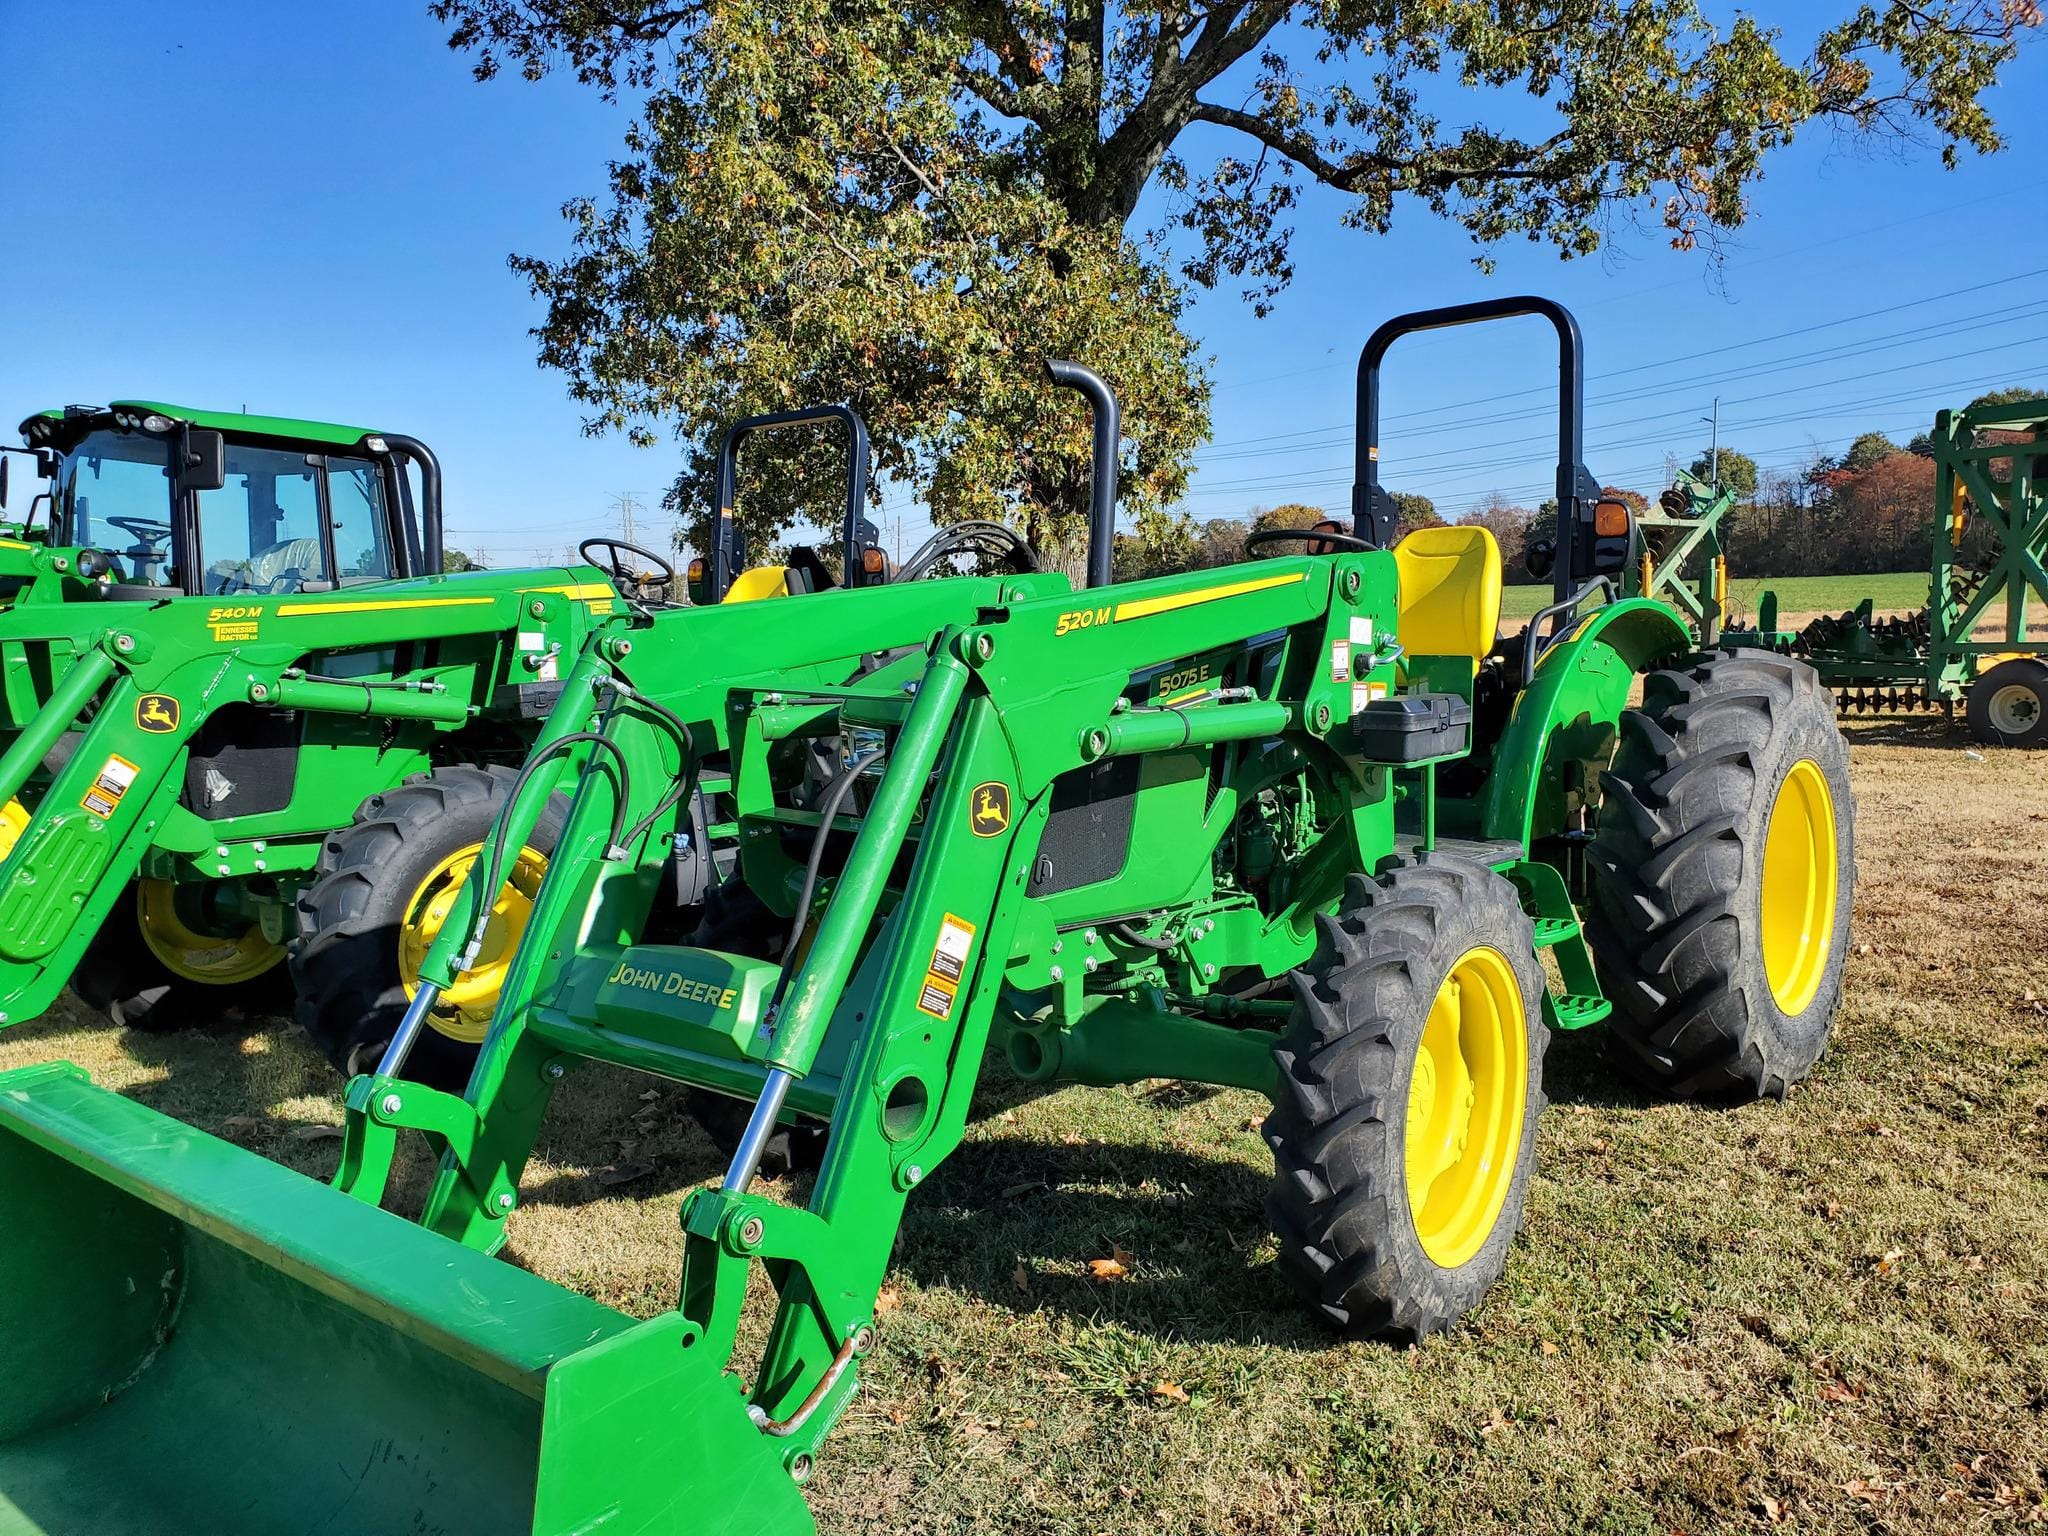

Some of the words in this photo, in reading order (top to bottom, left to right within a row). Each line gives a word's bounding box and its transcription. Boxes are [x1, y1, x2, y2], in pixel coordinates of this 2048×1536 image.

[208, 607, 246, 622] 540
[247, 606, 263, 618] M
[1055, 609, 1094, 636] 520
[1094, 606, 1112, 626] M
[1159, 668, 1198, 697] 5075
[1200, 664, 1210, 681] E
[609, 963, 663, 991] JOHN
[662, 972, 737, 1009] DEERE
